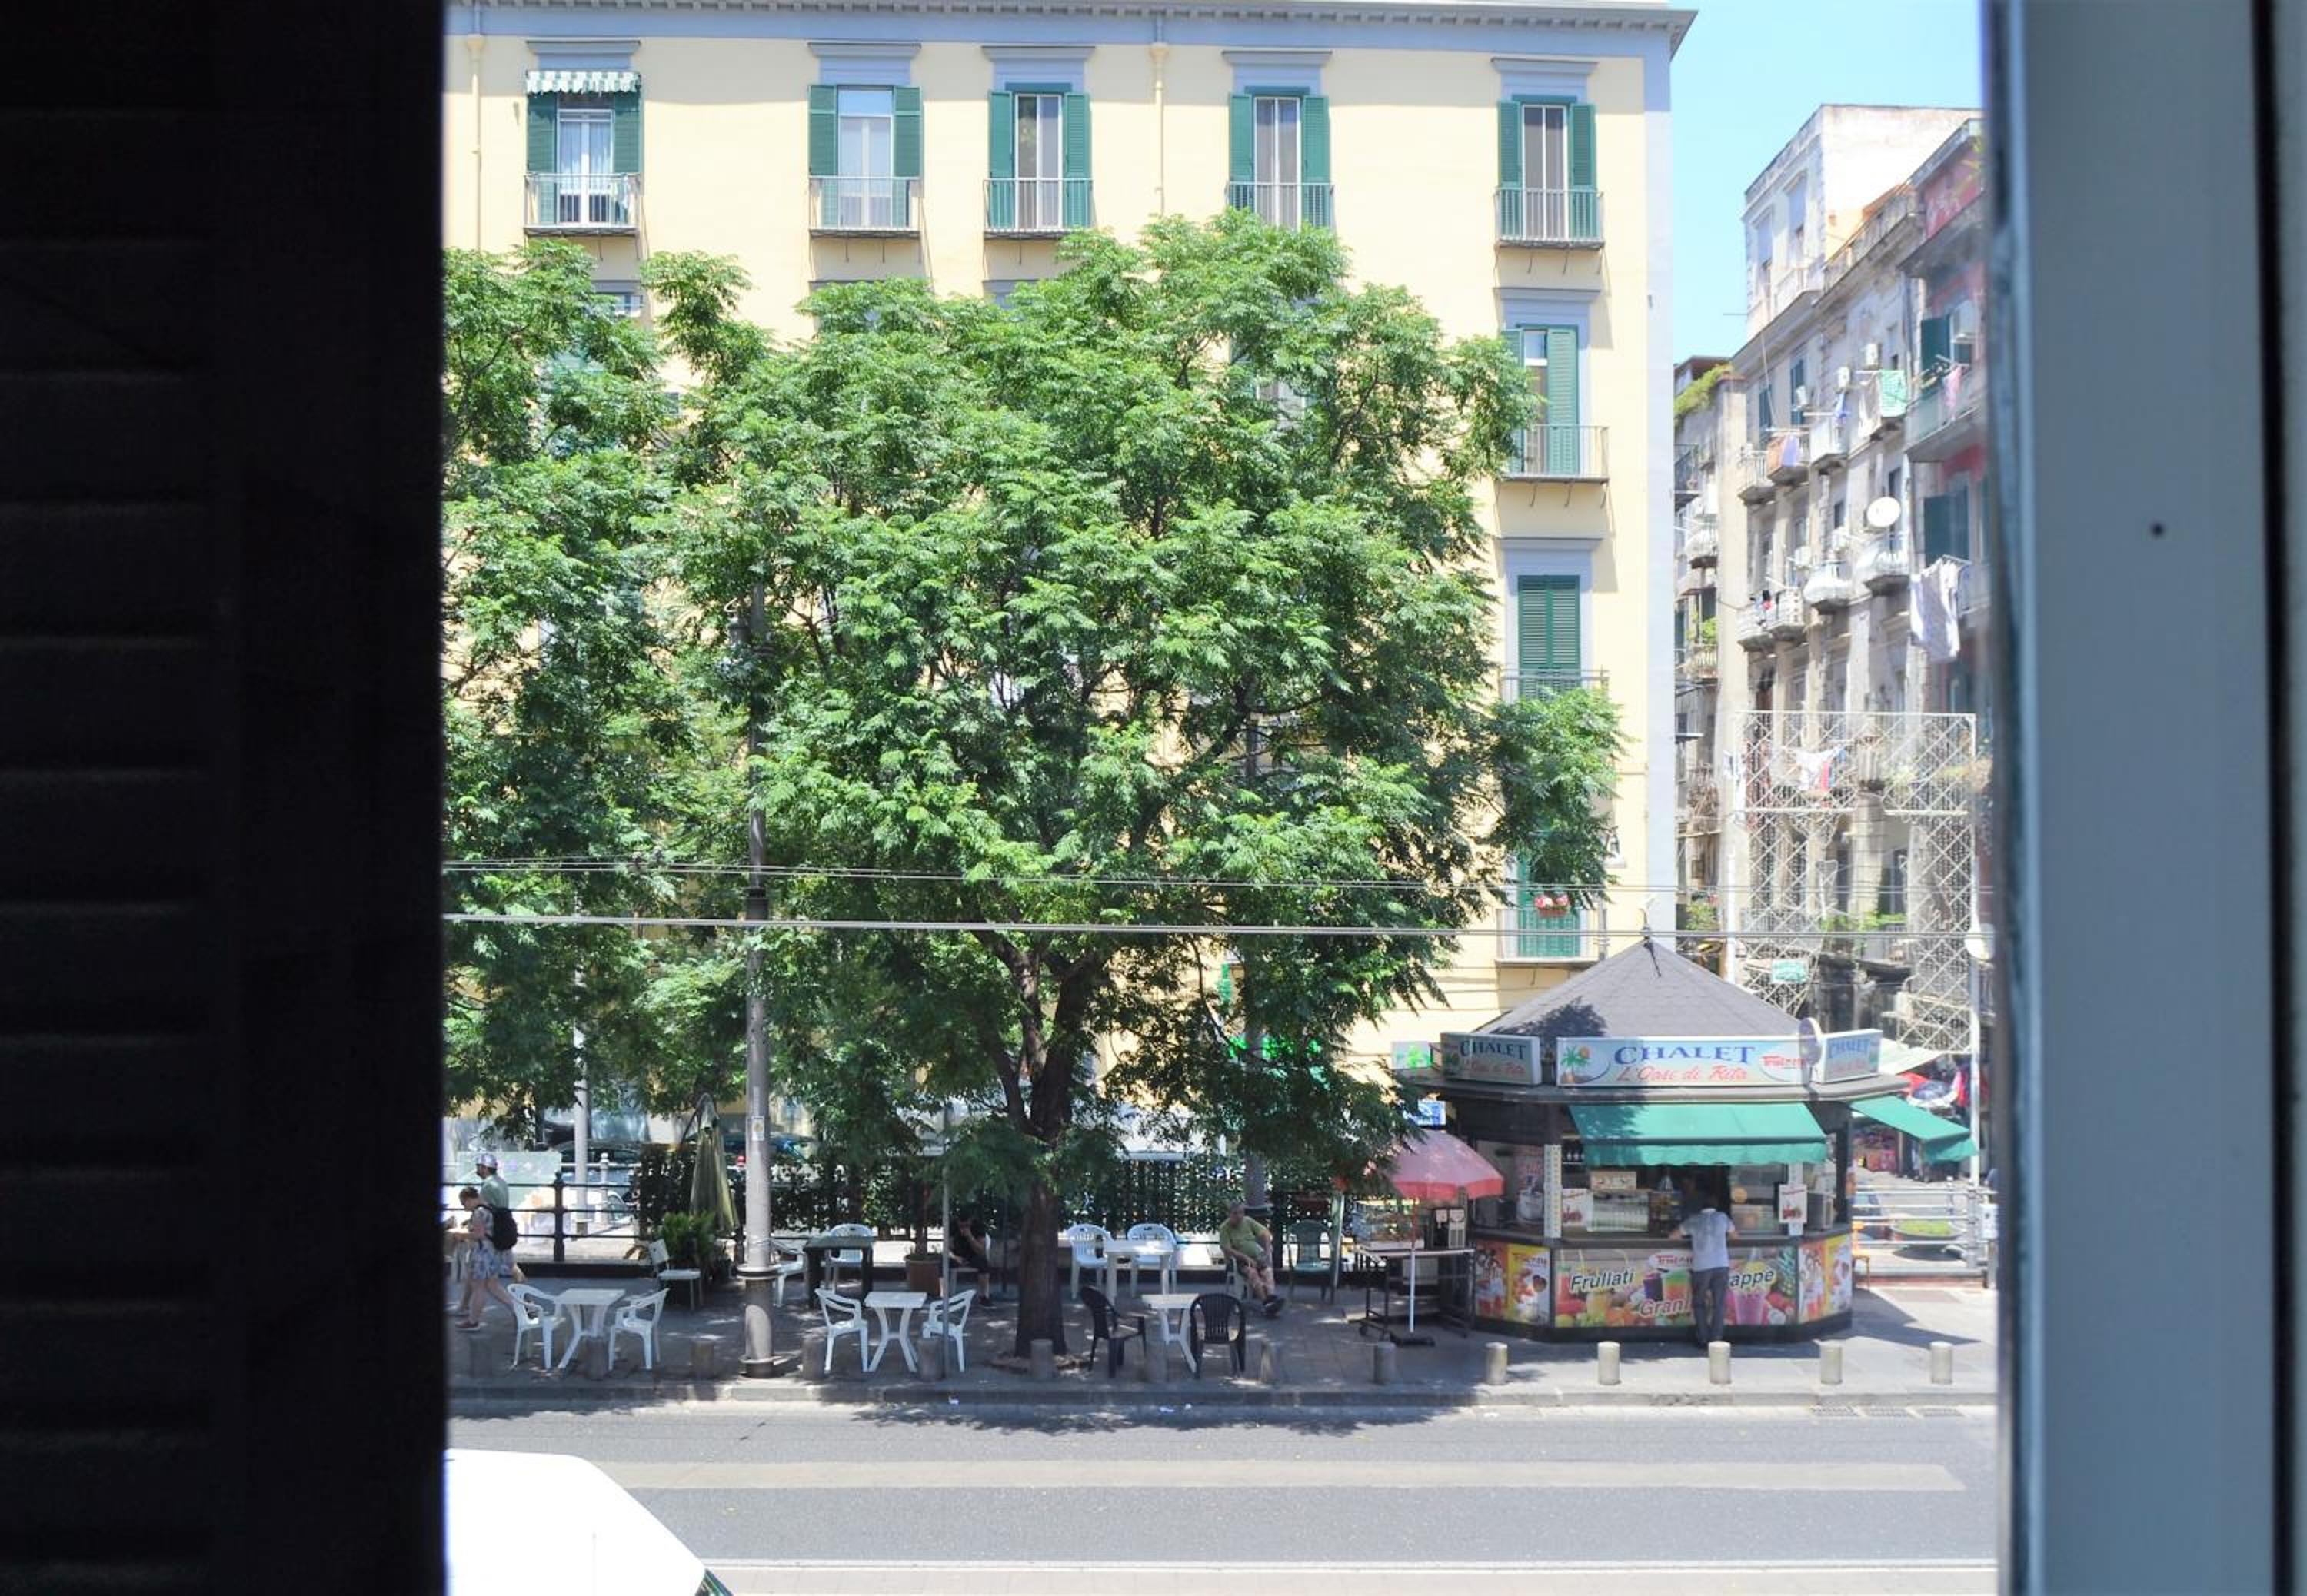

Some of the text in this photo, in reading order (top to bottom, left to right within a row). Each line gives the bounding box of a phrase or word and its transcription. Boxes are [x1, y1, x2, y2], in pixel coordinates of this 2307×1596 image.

[1460, 1039, 1526, 1060] CHALET
[1615, 1046, 1756, 1065] CHALET
[1570, 1271, 1633, 1289] Frullati
[1729, 1270, 1774, 1290] appe
